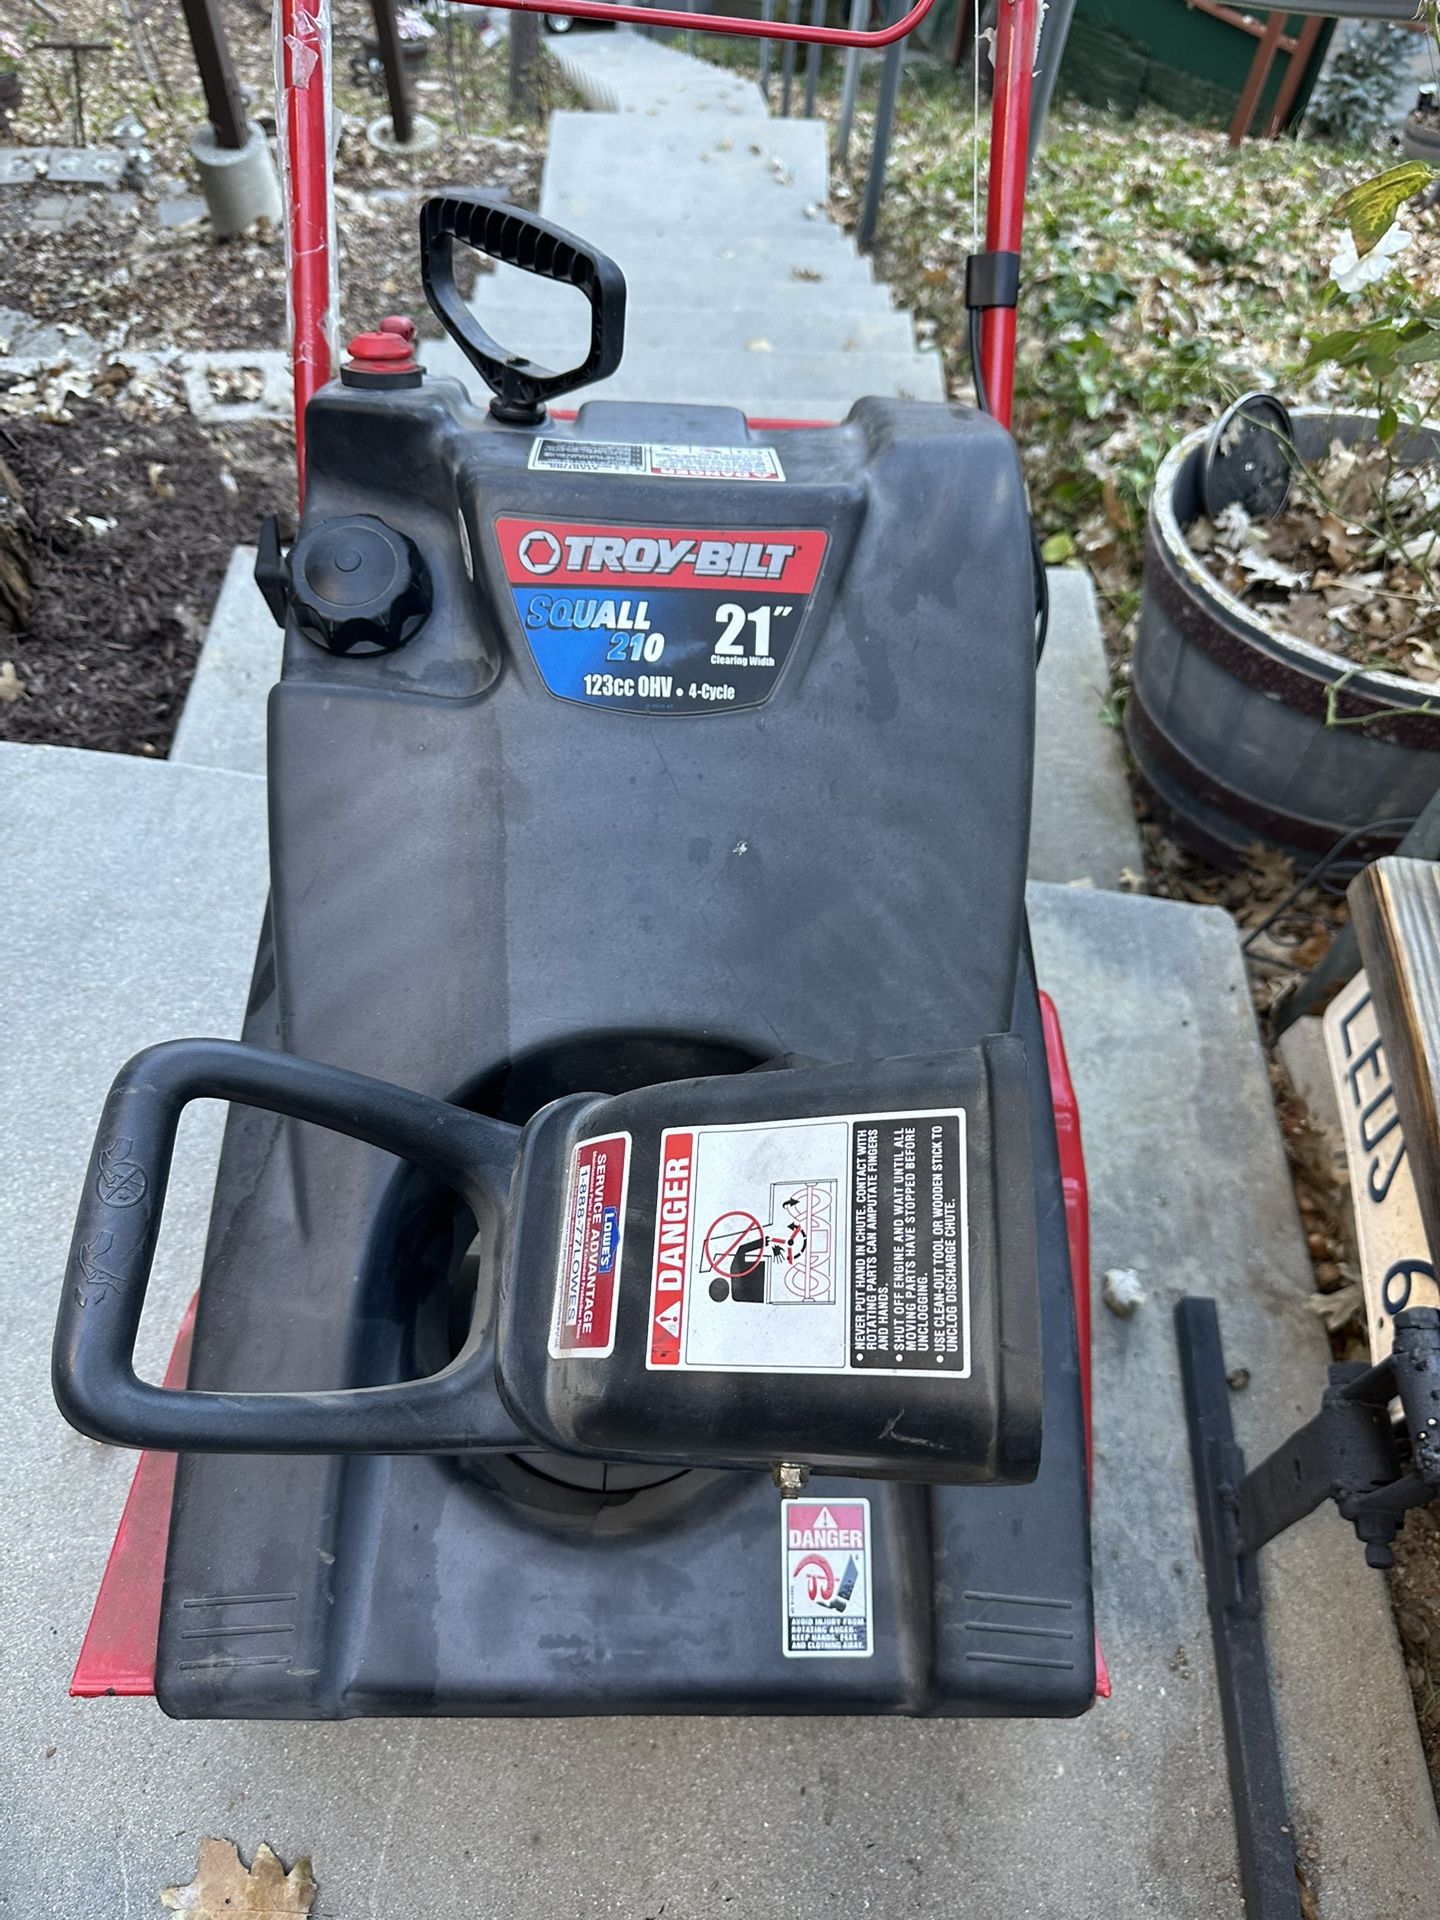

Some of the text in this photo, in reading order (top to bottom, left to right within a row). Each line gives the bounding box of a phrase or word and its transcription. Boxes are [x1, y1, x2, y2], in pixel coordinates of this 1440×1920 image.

[564, 536, 795, 579] TROY-BILT
[527, 596, 651, 631] SQUALL
[606, 632, 665, 662] 210
[711, 654, 775, 667] Clearing Width
[583, 674, 736, 700] 123cc OHV 4-Cycle
[568, 1169, 588, 1320] 1-888-77LOWES
[583, 1154, 606, 1333] SERVICE ADVANTAGE
[601, 1212, 615, 1266] LOWE'S
[658, 1157, 689, 1291] DANGER
[856, 1130, 867, 1349] NEVER PUT HAND IN CHUTE. CONTACT WITH
[867, 1129, 878, 1349] ROTATING PARTS CAN AMPUTATE FINGERS
[894, 1128, 904, 1350] SHUT OFF ENGINE AND WAIT UNTIL ALL
[905, 1128, 916, 1350] MOVING PARTS HAVE STOPPED BEFORE
[932, 1126, 946, 1352] USE CLEAN-OUT TOOL OR WOODEN STICK TO
[578, 1283, 586, 1320] Protection
[945, 1199, 958, 1352] UNCLOG DISCHARGE CHUTE.
[878, 1283, 888, 1350] AND HANDS.
[917, 1273, 929, 1351] UNCLOGGING.
[789, 1529, 863, 1549] DANGER
[791, 1617, 814, 1626] AVOID
[842, 1617, 865, 1626] FROM
[791, 1625, 828, 1634] ROTATING
[791, 1633, 811, 1641] KEEP
[840, 1633, 858, 1641] FEET
[791, 1641, 807, 1650] AND
[807, 1641, 842, 1650] CLOTHING
